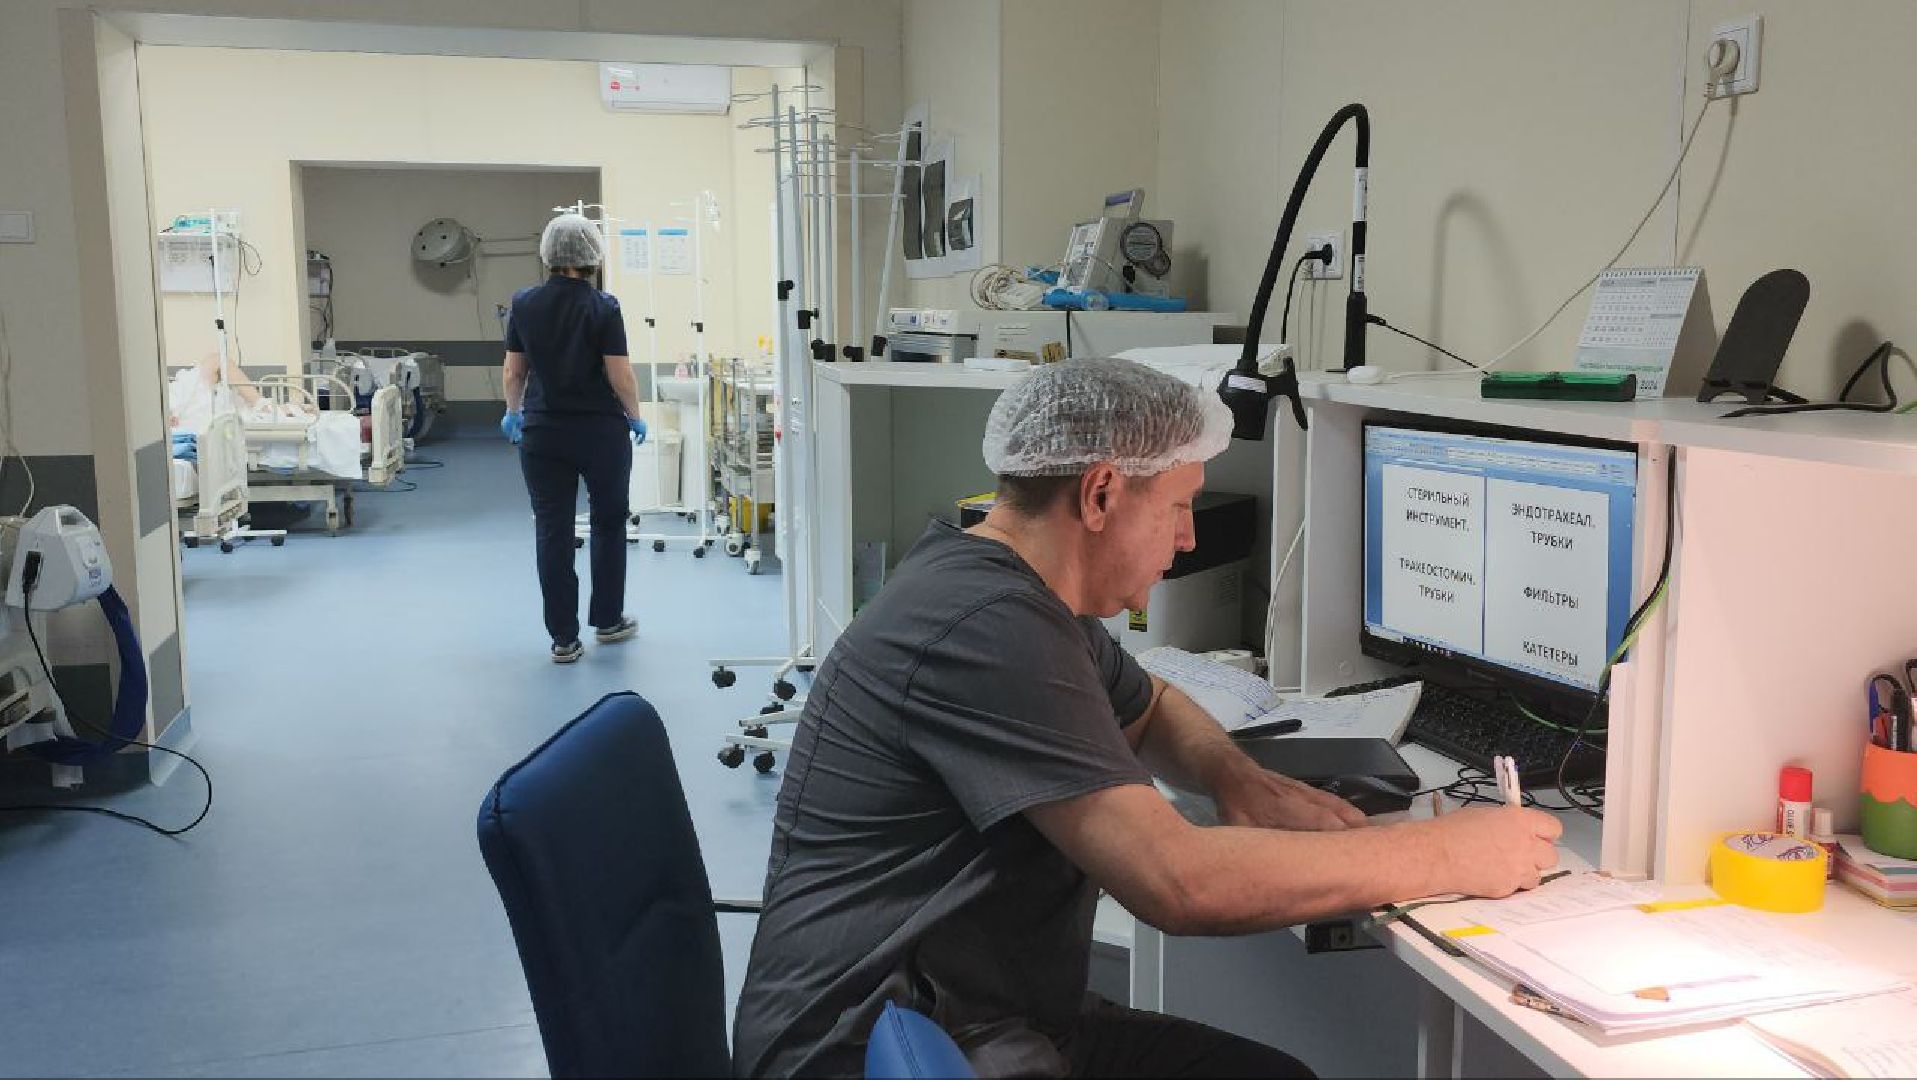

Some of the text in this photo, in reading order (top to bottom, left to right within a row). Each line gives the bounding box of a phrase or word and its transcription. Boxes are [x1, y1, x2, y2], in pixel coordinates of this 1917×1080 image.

[1407, 486, 1469, 507] СТЕРИЛЬНЫЙ
[1406, 508, 1470, 532] ИНСТРУМЕНТ.
[1511, 503, 1596, 528] ЭНДОТРАХЕАЛ.
[1530, 530, 1573, 550] ТРУБКИ
[1400, 557, 1476, 585] ТРАХЕОСТОМИЧ.
[1418, 584, 1455, 603] ТРУБКИ
[1523, 586, 1579, 609] ФИЛЬТРЫ
[1523, 640, 1578, 666] КАТЕТЕРЫ
